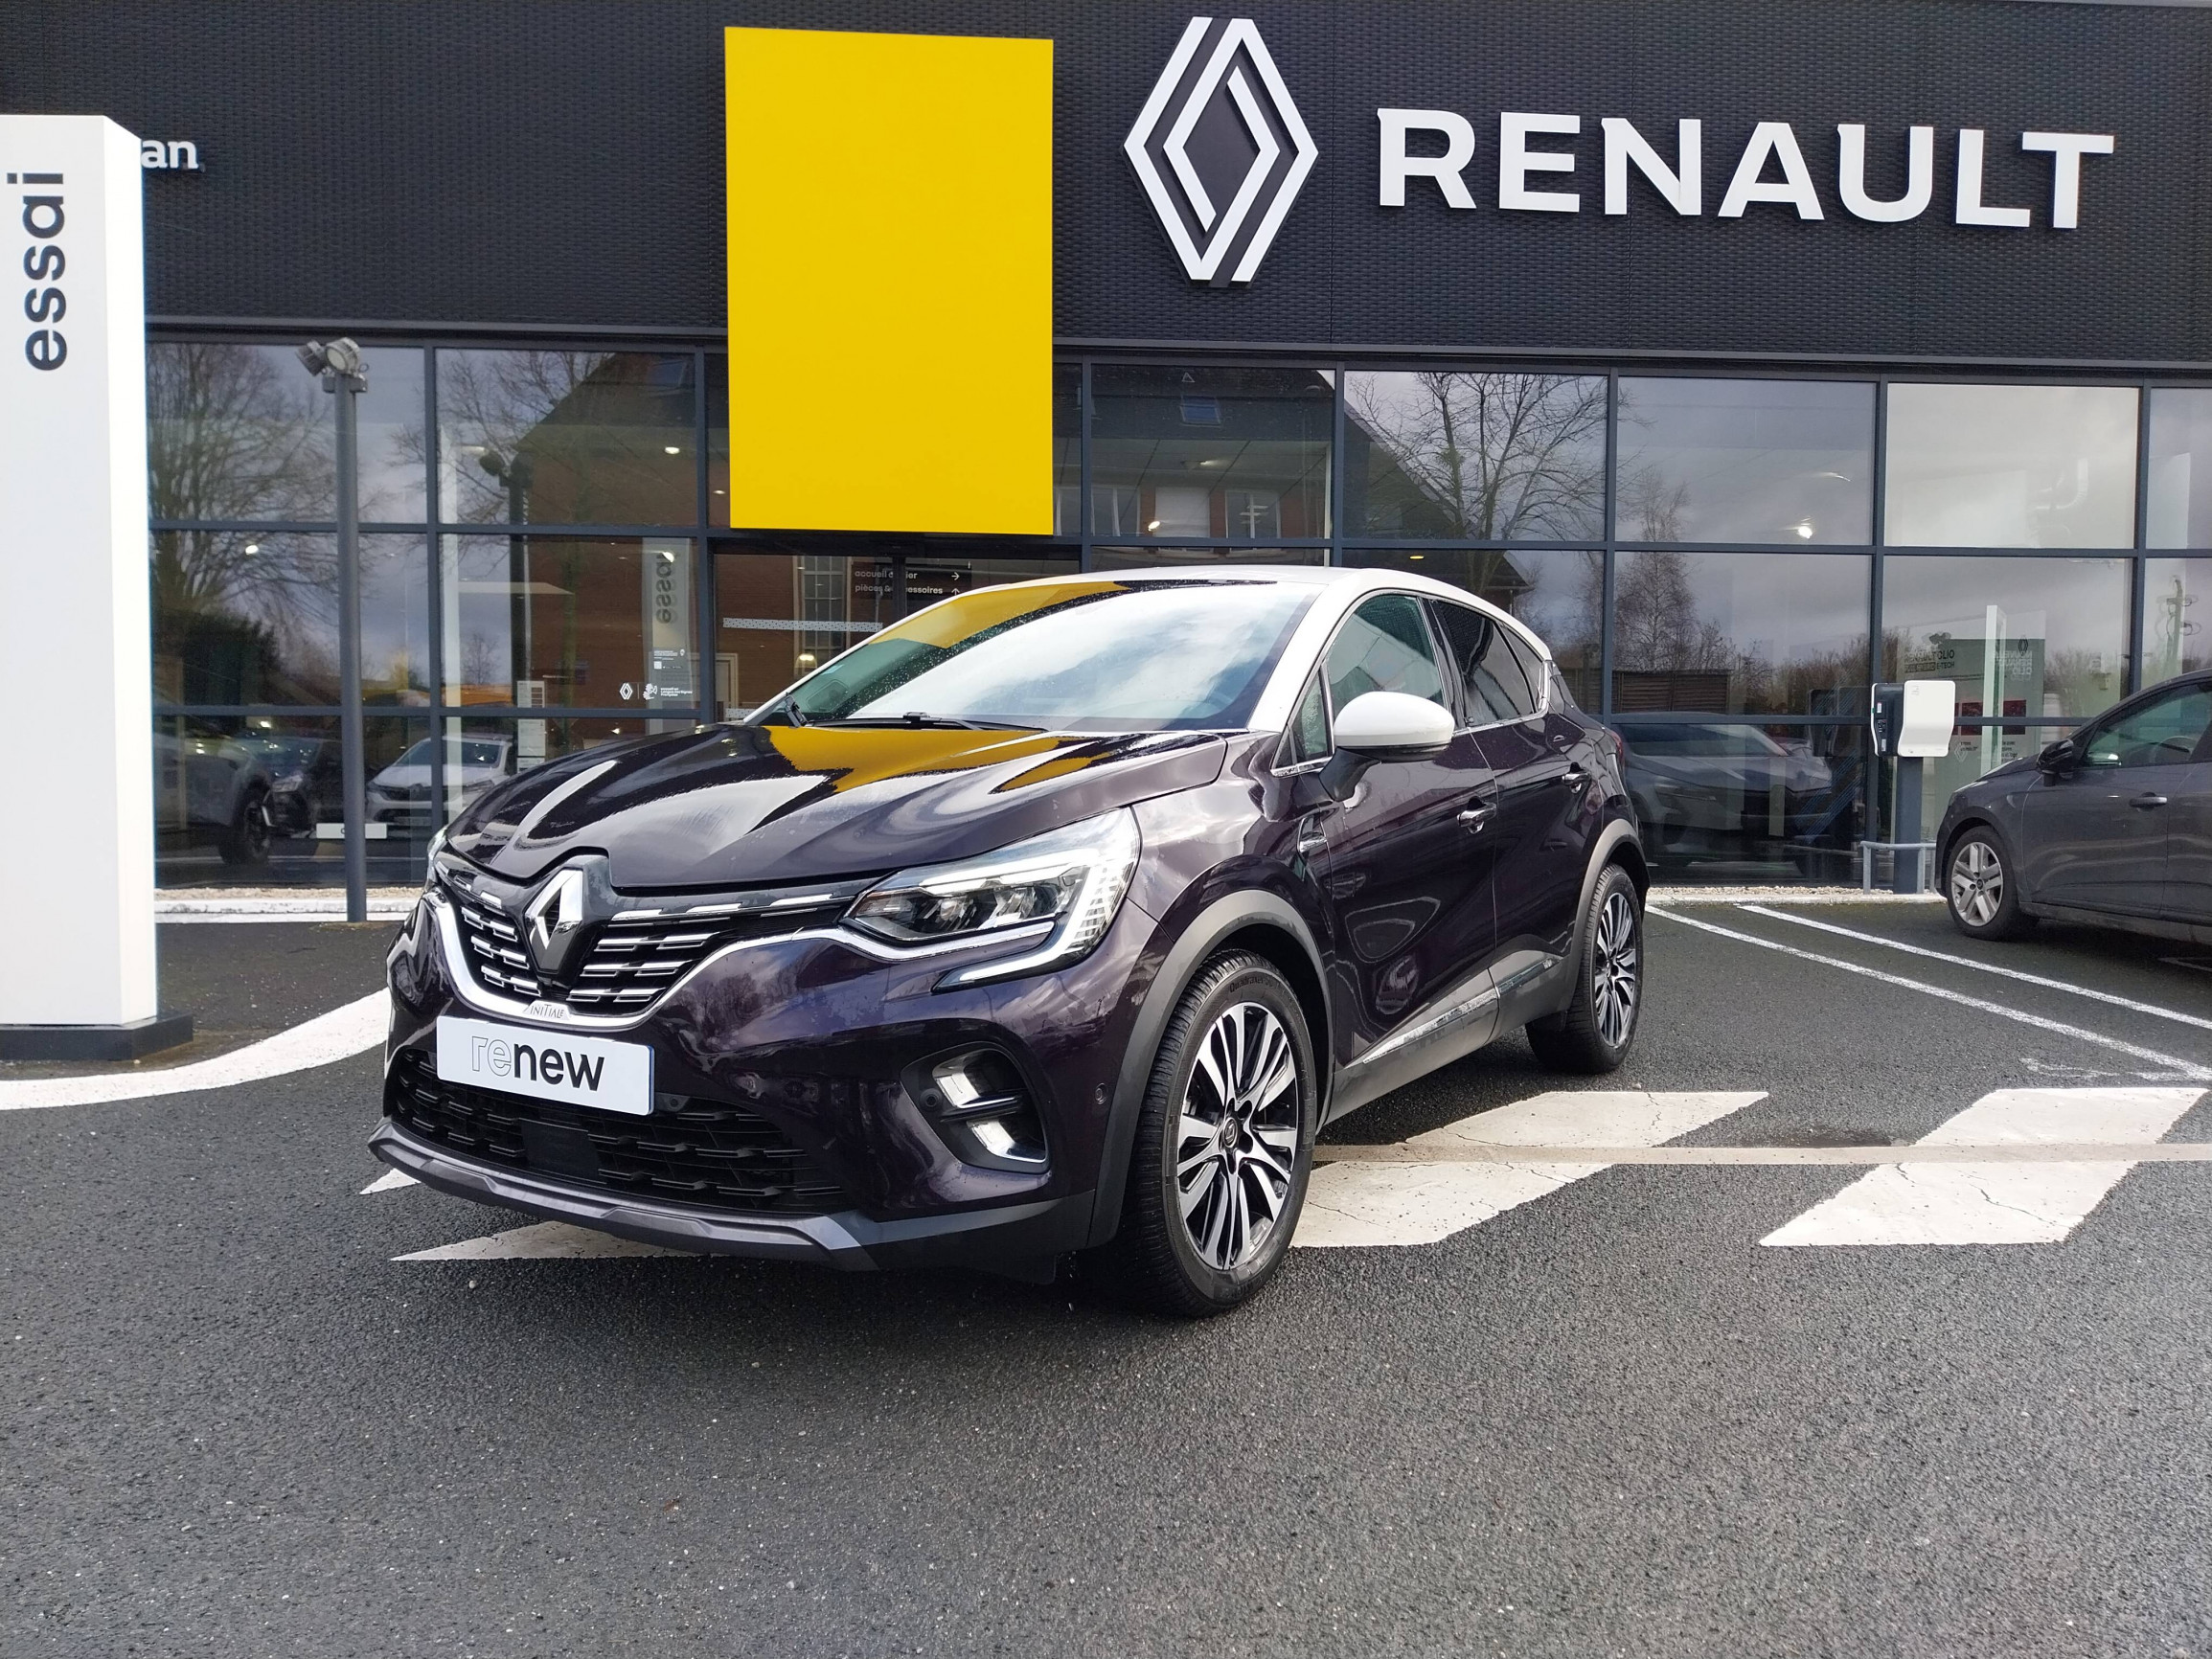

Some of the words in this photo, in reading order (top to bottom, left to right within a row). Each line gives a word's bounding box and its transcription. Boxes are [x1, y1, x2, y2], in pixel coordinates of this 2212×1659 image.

[1377, 107, 2114, 229] RENAULT
[7, 172, 68, 371] essai
[530, 1004, 564, 1018] INITIALE
[471, 1035, 604, 1091] renew
